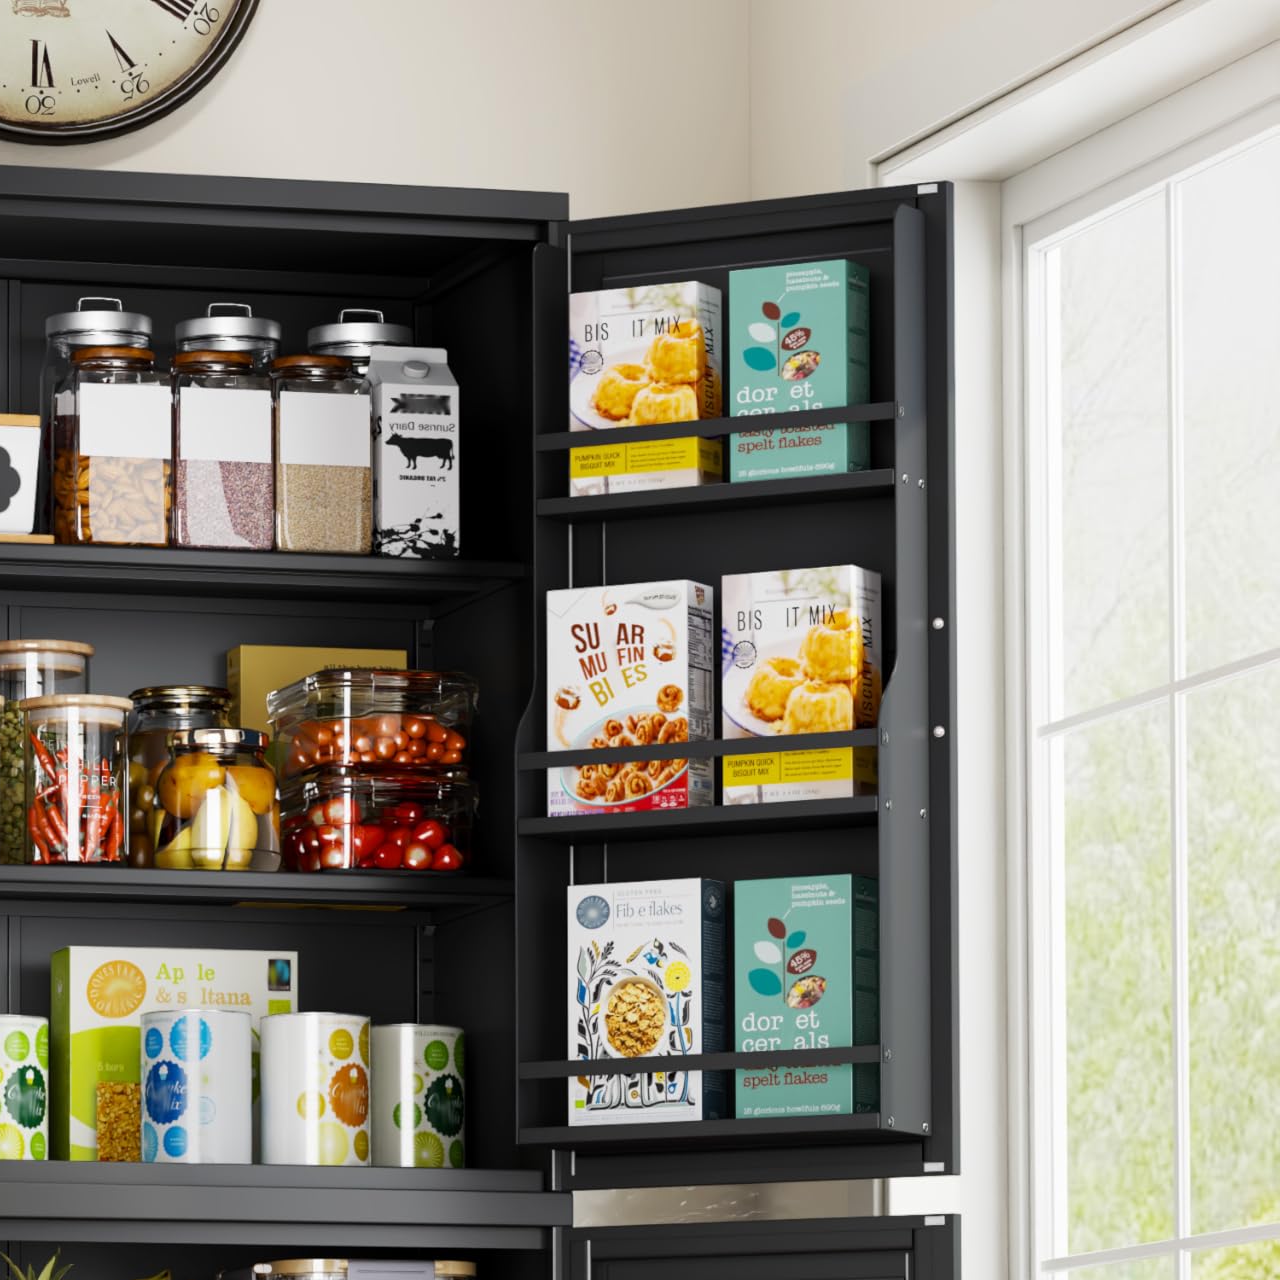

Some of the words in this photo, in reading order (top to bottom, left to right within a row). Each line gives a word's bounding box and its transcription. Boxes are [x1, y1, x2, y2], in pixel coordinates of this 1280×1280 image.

[106, 29, 138, 73] V
[30, 39, 55, 88] VI
[70, 73, 101, 87] Lowell
[25, 95, 56, 115] 30
[584, 322, 609, 342] BIS
[632, 319, 645, 338] IT
[654, 315, 680, 335] MIX
[736, 386, 778, 403] dor
[790, 381, 814, 398] et
[738, 438, 775, 453] spelt
[779, 435, 822, 449] flakes
[737, 610, 762, 631] BIS
[786, 606, 800, 627] IT
[809, 604, 836, 625] MIX
[570, 622, 600, 653] SU
[616, 623, 645, 645] AR
[862, 617, 873, 648] MIX
[579, 652, 608, 680] MU
[617, 646, 644, 666] FIN
[589, 677, 615, 707] BI
[621, 664, 648, 688] ES
[727, 759, 755, 768] PUMPKIN
[758, 768, 769, 776] MIX
[616, 902, 634, 919] Fib
[638, 906, 646, 917] e
[649, 900, 683, 917] flakes
[155, 963, 184, 984] Ap
[197, 963, 215, 981] le
[177, 991, 187, 1004] s
[201, 988, 252, 1005] ltana
[742, 1012, 784, 1032] dor
[795, 1010, 820, 1029] et
[742, 1037, 781, 1052] cer
[794, 1032, 829, 1049] als
[743, 1073, 780, 1089] spelt
[784, 1072, 828, 1085] flakes
